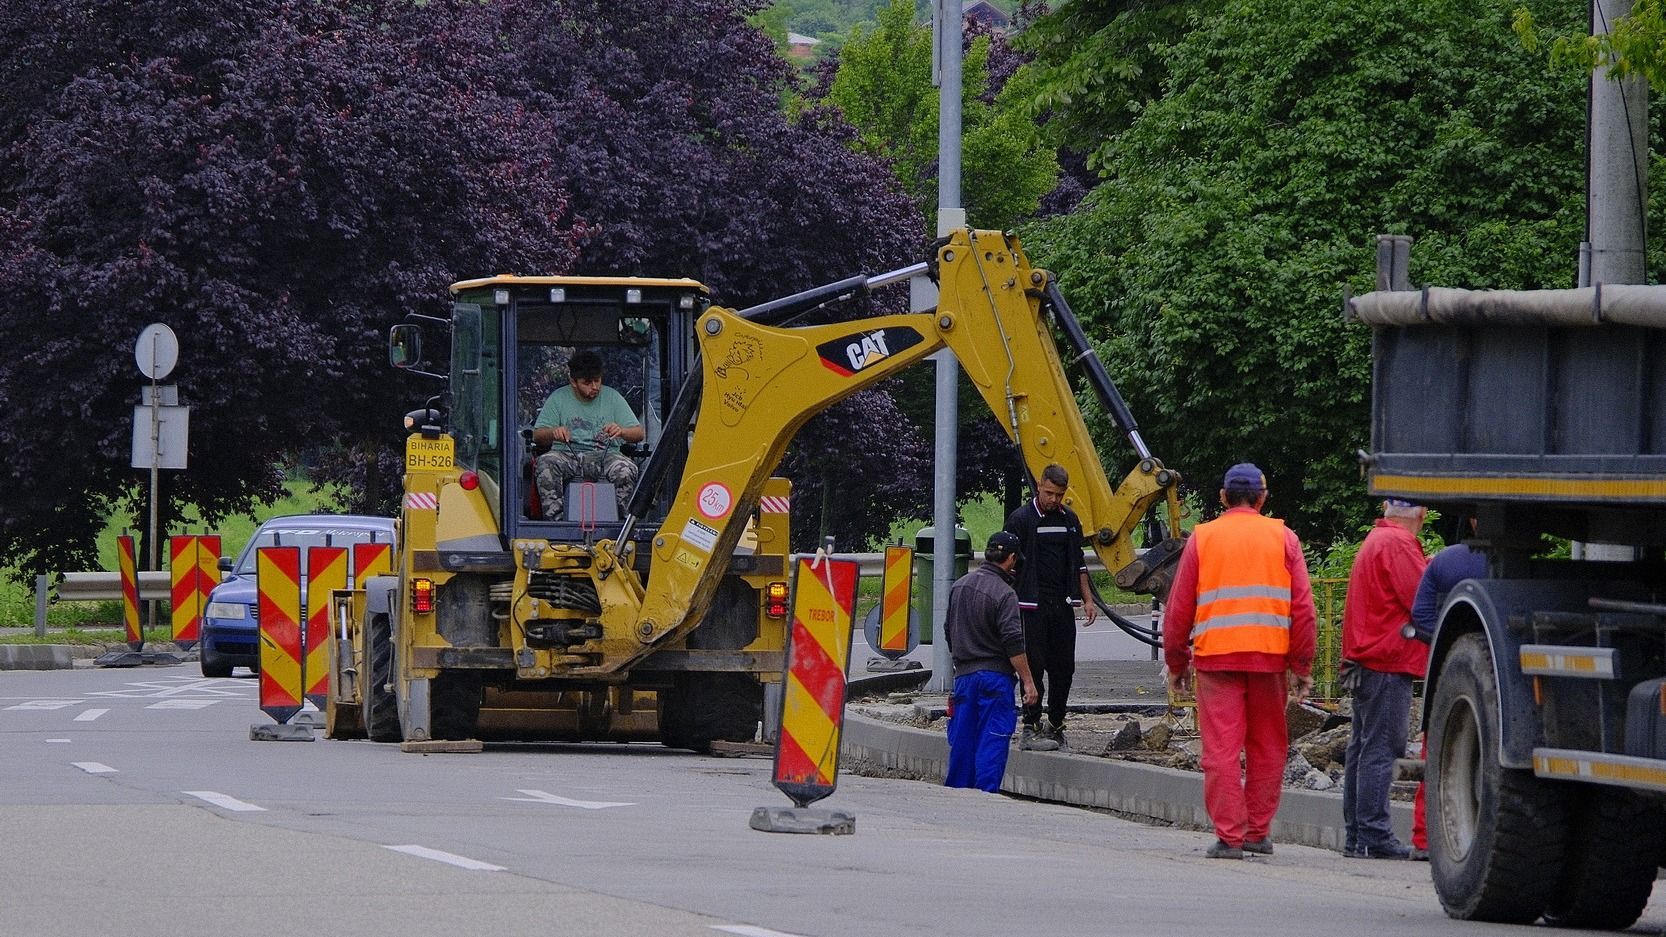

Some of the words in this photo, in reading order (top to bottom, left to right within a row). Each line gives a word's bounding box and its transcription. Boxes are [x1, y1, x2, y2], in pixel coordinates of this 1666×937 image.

[846, 329, 890, 370] CAT
[411, 441, 450, 451] BIHARIA
[409, 454, 452, 468] BH-526
[808, 608, 836, 623] TREBOR
